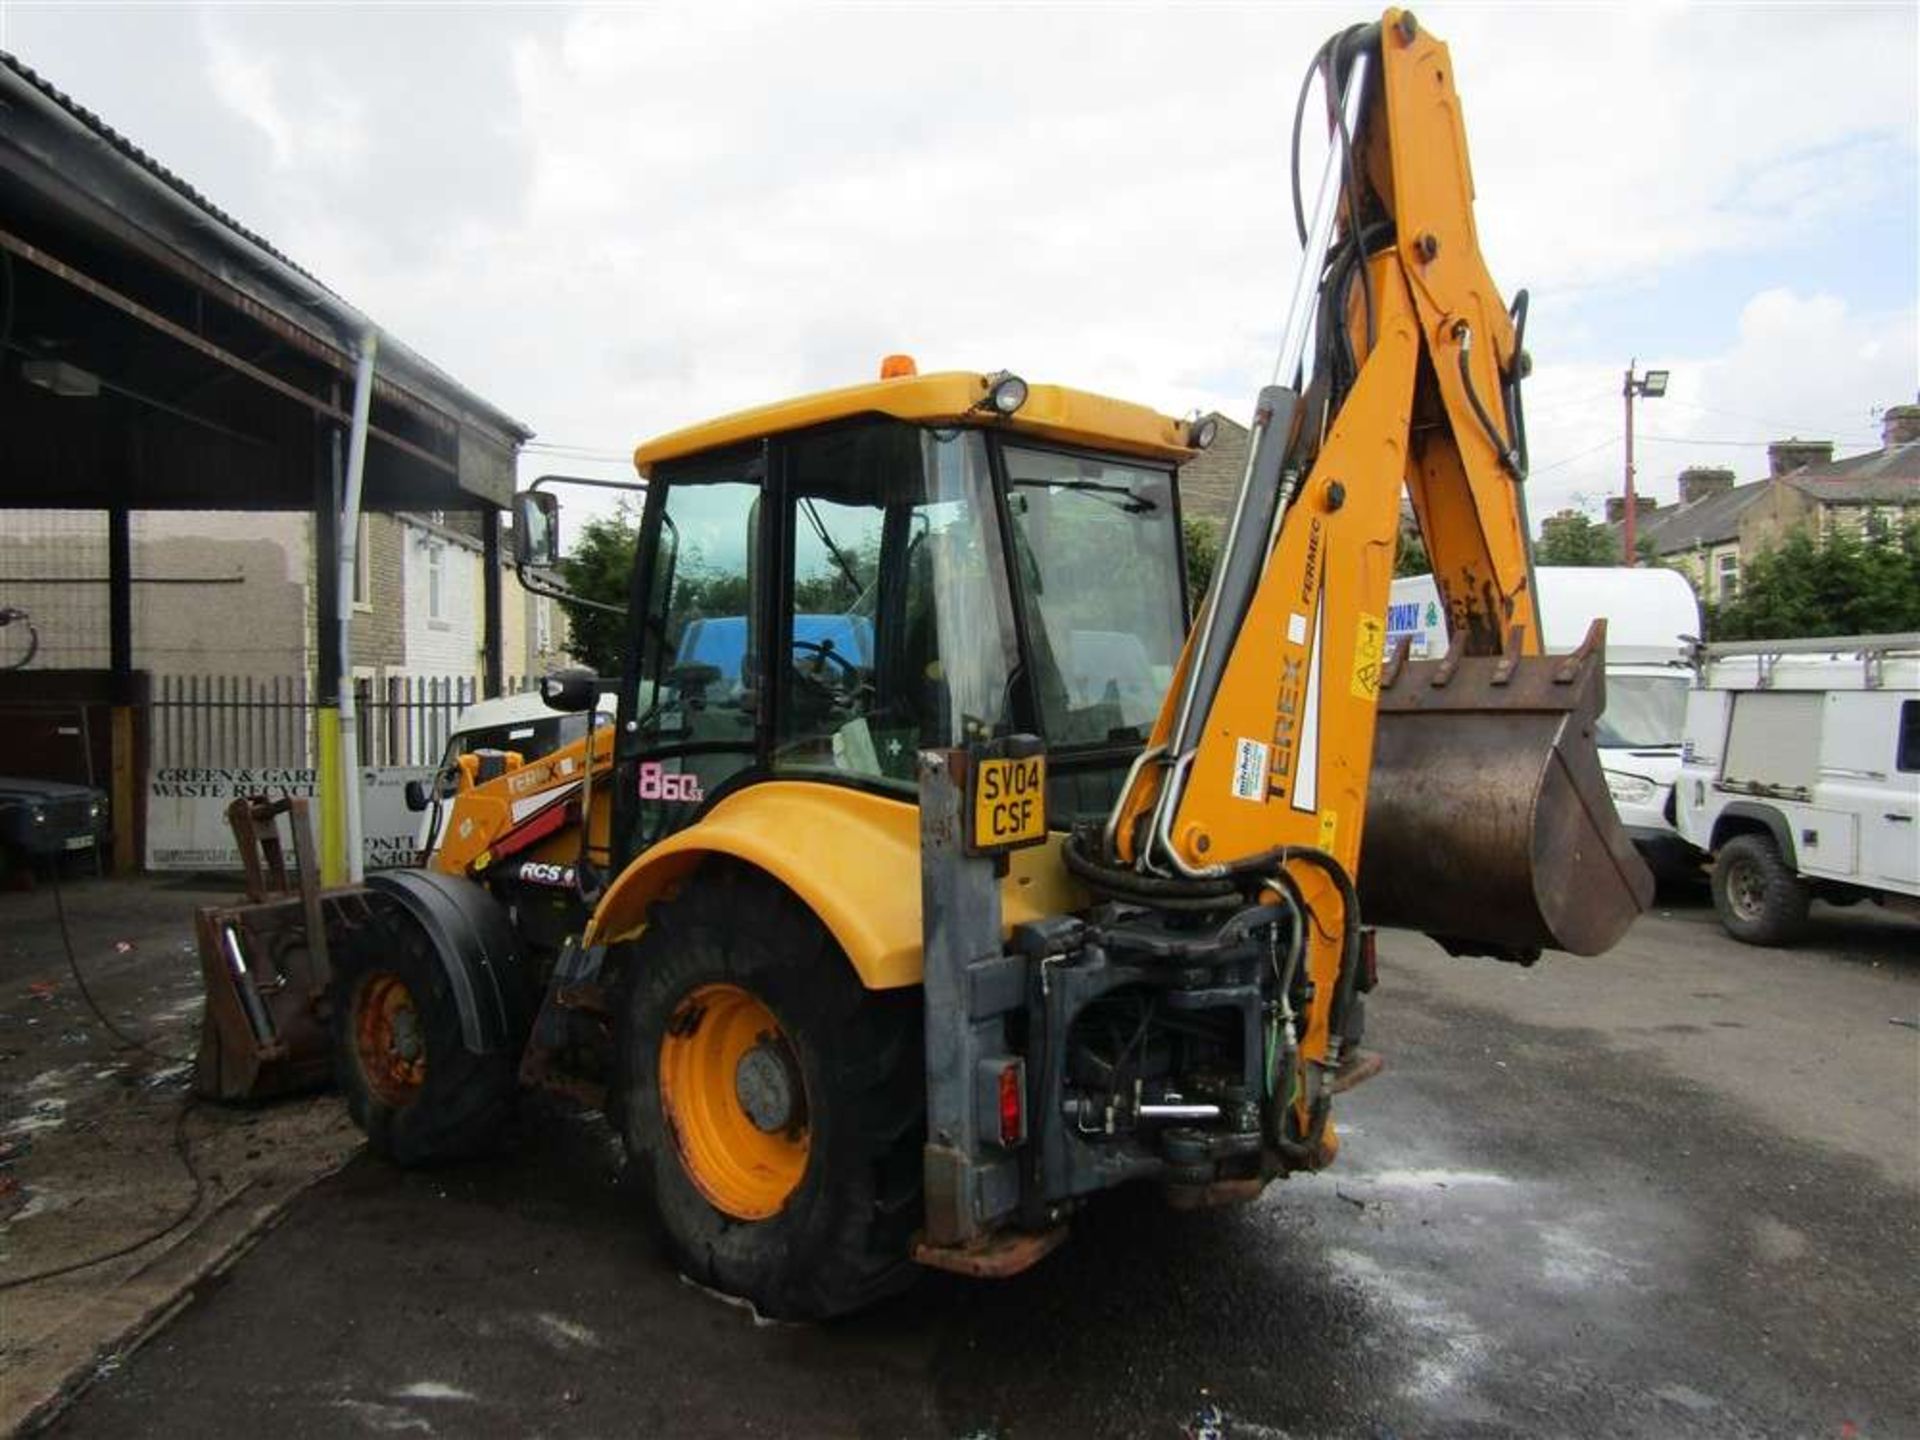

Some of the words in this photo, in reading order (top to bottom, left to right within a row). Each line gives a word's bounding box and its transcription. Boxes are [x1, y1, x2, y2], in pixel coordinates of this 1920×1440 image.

[1301, 517, 1320, 606] FERMEC
[1265, 654, 1302, 804] TEREX
[152, 783, 226, 799] WASTE
[158, 768, 235, 783] GREEN
[984, 760, 1039, 800] SV04
[993, 799, 1033, 836] CSF
[520, 862, 562, 884] RCS
